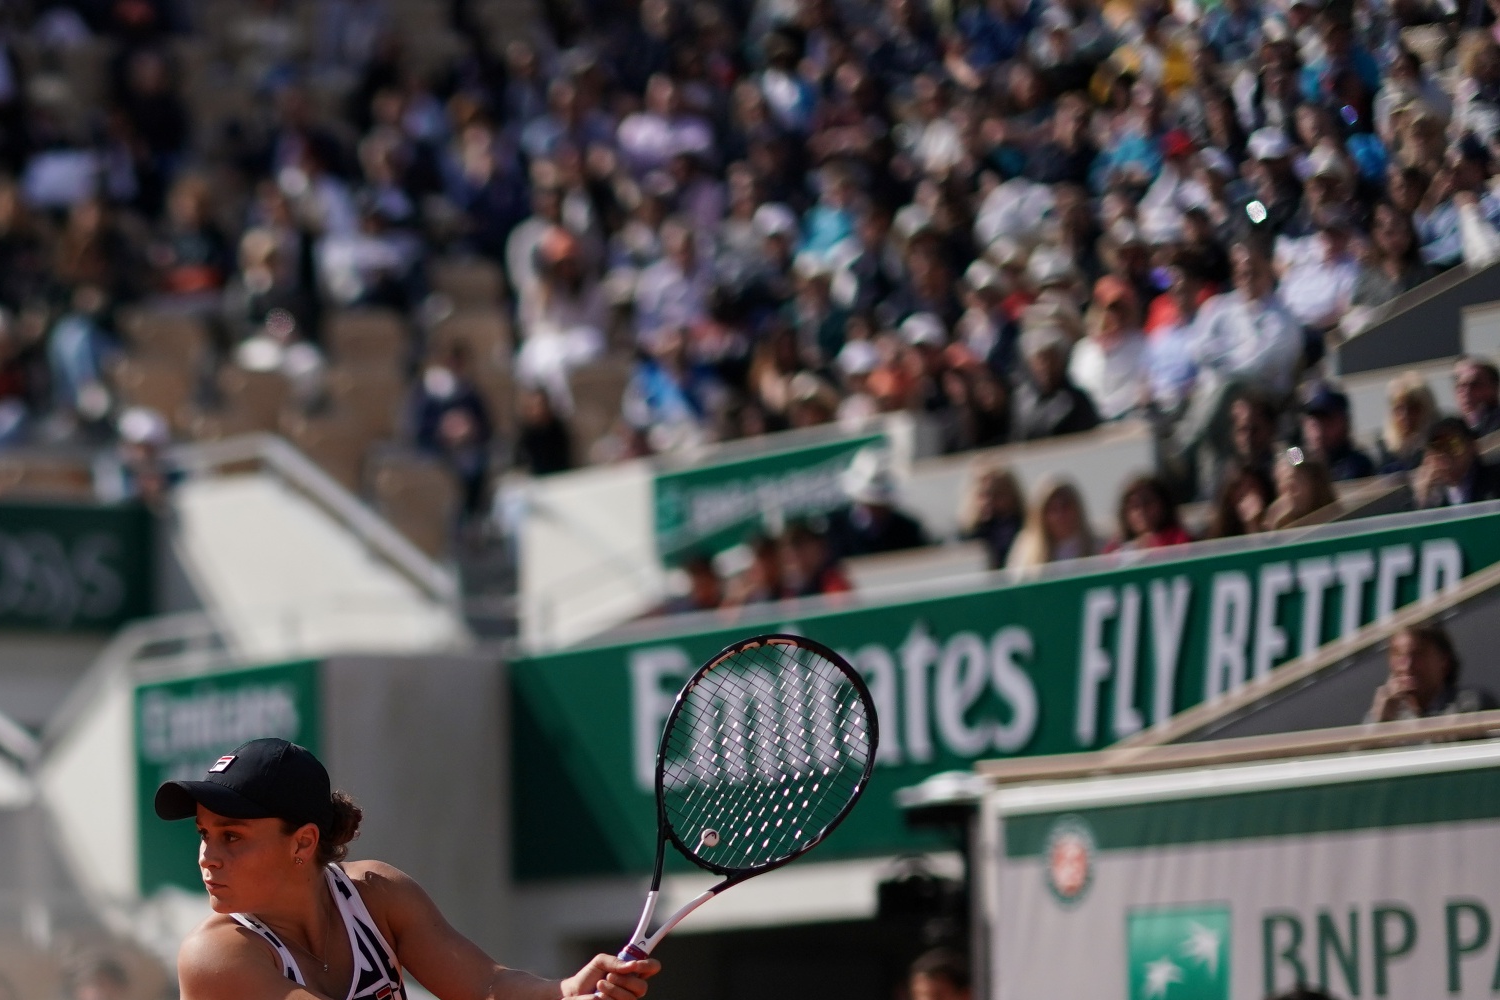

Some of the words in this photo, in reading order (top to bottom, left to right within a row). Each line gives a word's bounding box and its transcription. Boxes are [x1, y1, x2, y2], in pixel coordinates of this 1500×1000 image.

[629, 625, 1040, 794] Emirates
[1075, 573, 1194, 748] FLY
[1261, 904, 1418, 999] BNP
